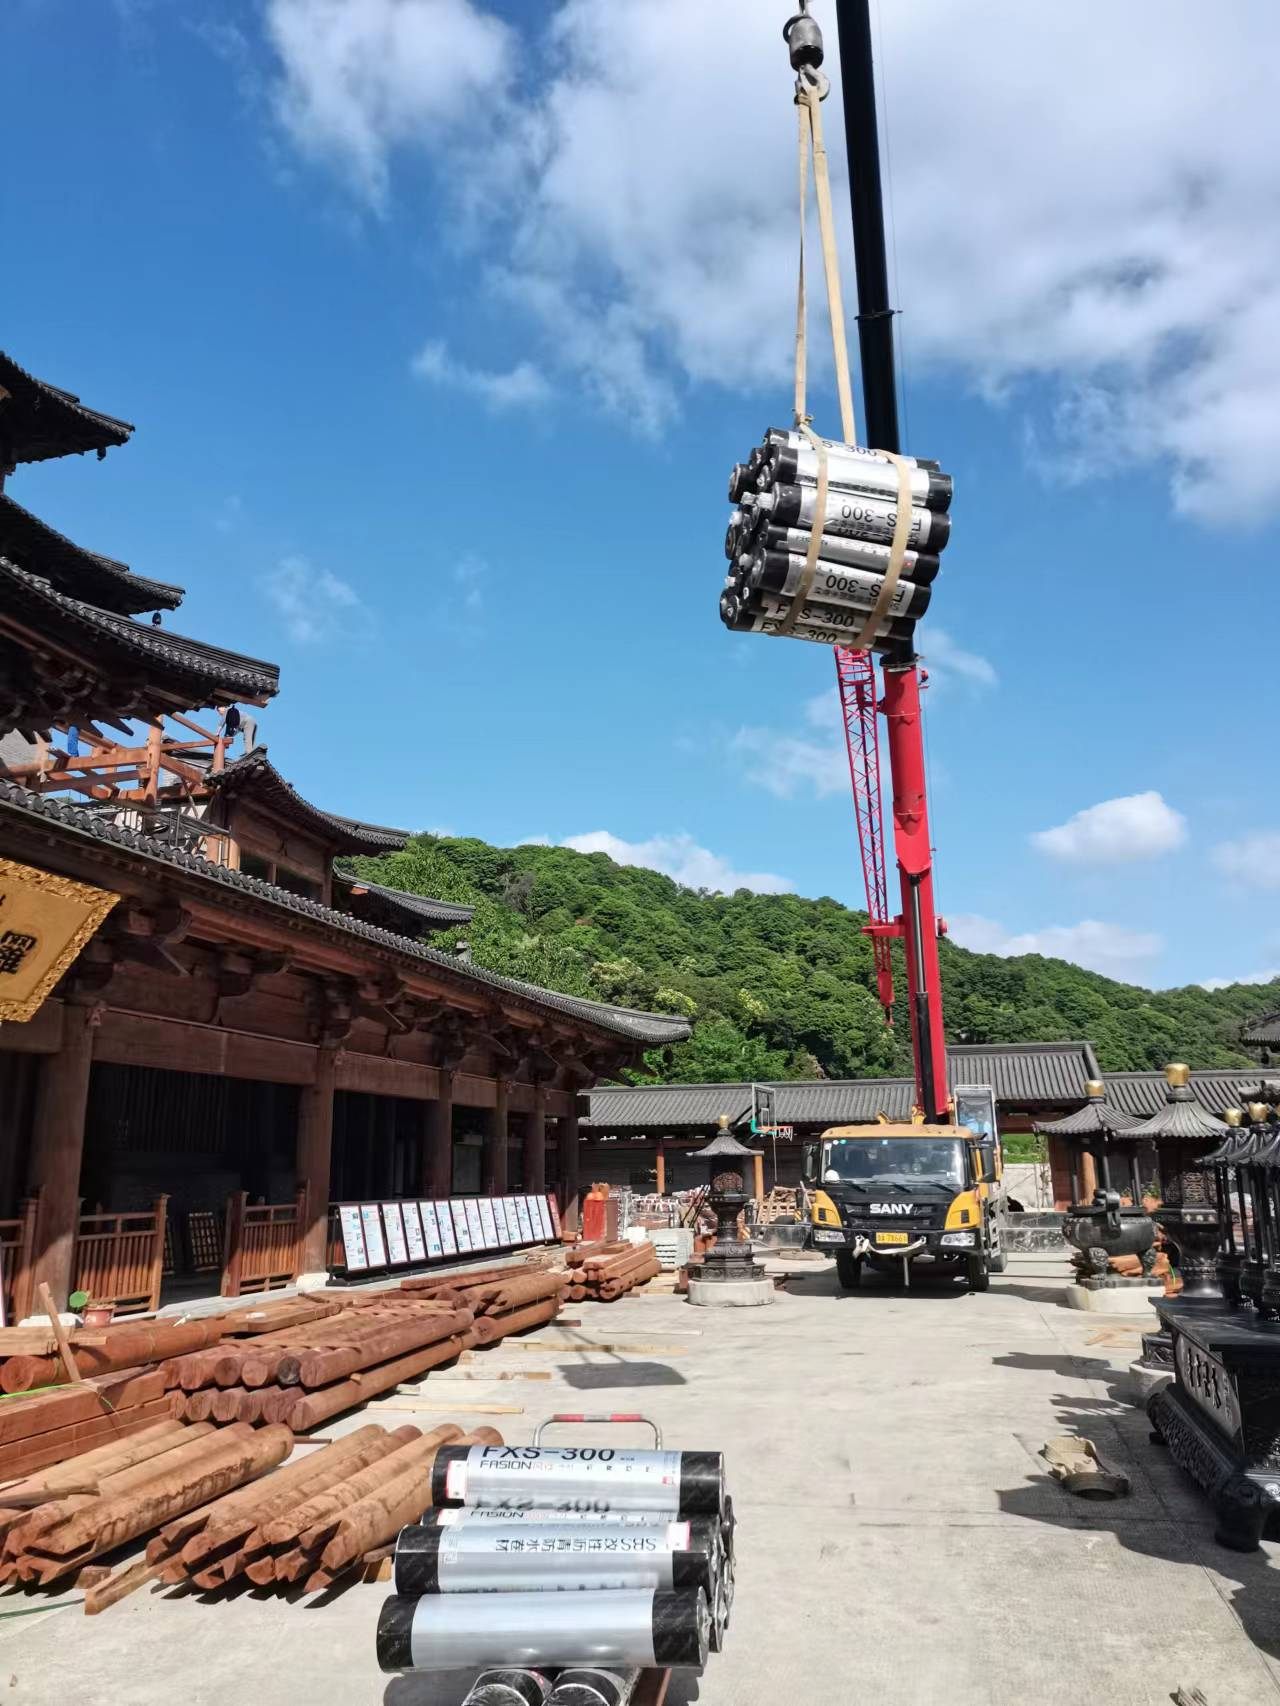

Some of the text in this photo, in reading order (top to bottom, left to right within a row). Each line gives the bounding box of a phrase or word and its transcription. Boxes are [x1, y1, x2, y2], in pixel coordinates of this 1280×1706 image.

[841, 505, 922, 531] FS-300
[826, 575, 905, 602] FS-300
[776, 602, 854, 627] FS-300
[870, 1203, 913, 1214] SANY
[482, 1446, 615, 1461] FXS-300
[480, 1459, 532, 1470] FASION
